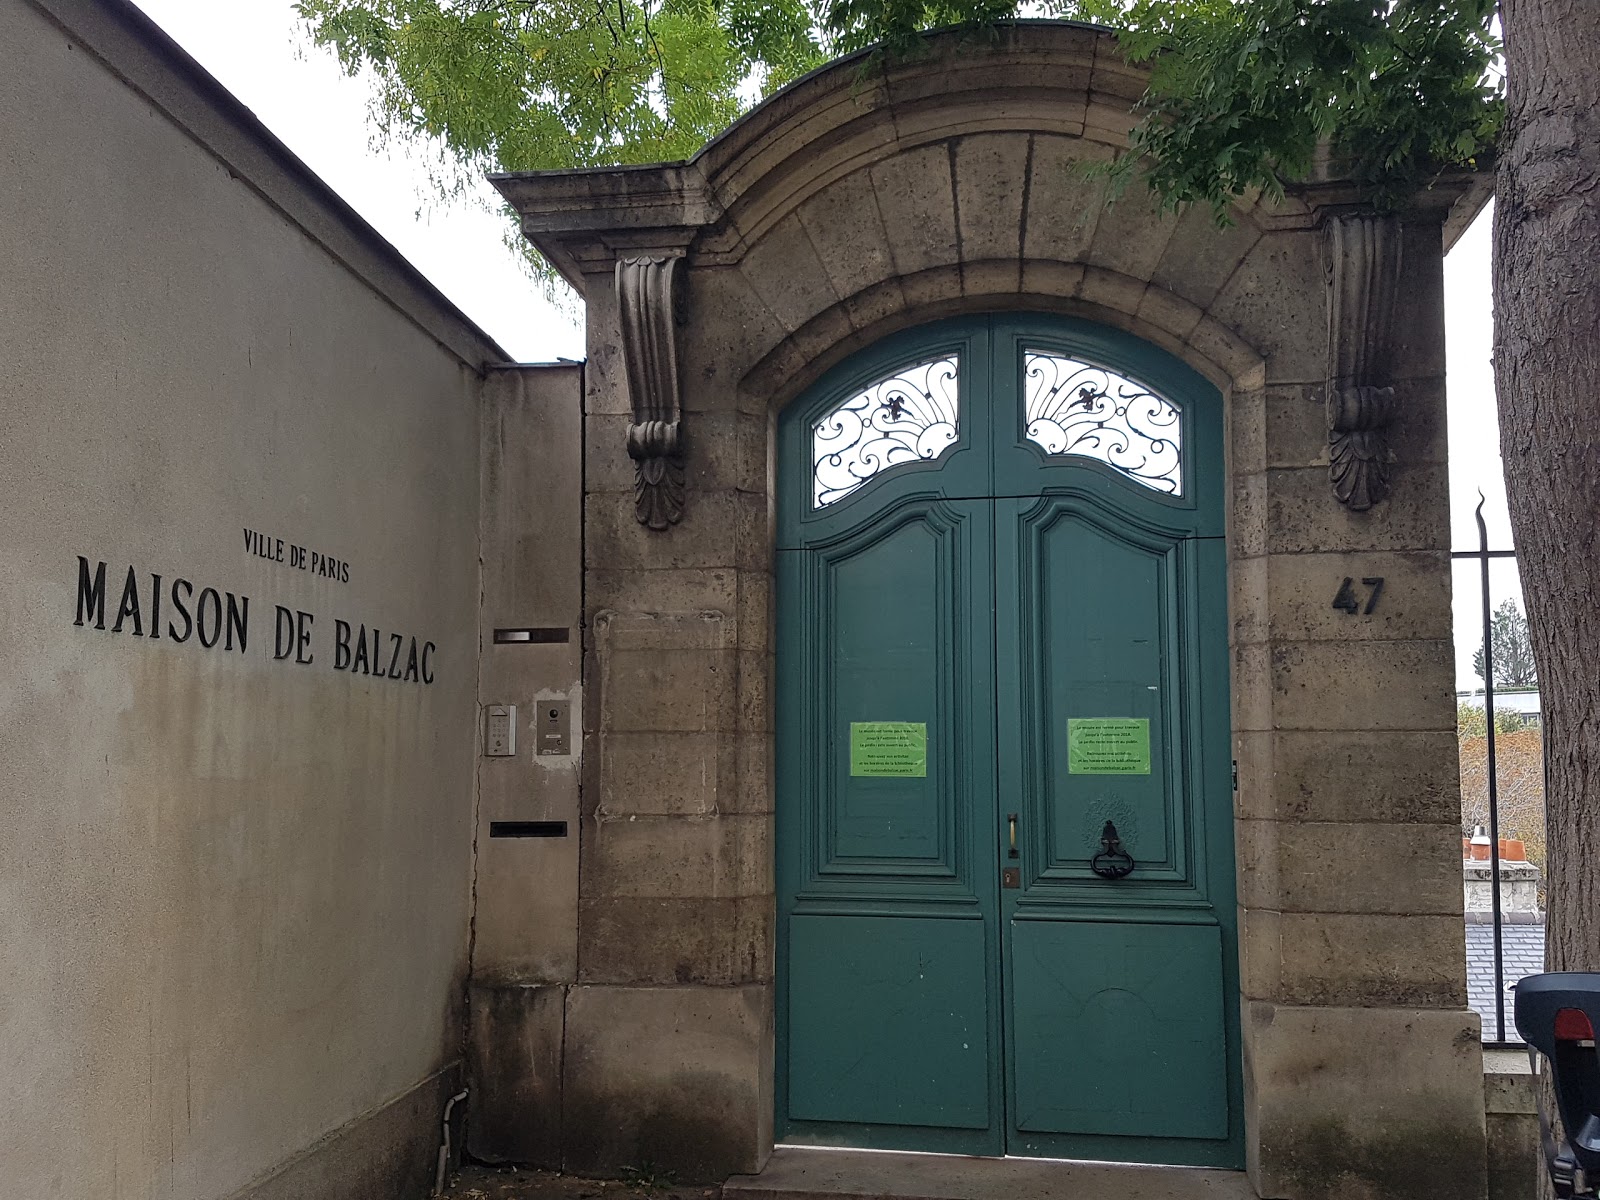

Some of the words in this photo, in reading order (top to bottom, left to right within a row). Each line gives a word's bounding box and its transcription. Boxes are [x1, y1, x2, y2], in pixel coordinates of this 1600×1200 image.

[243, 528, 284, 562] VILLE
[290, 544, 307, 570] DE
[312, 554, 349, 583] PARIS
[73, 556, 249, 654] MAISON
[273, 605, 313, 664] DE
[334, 619, 435, 684] BALZAC
[1332, 577, 1384, 615] 47
